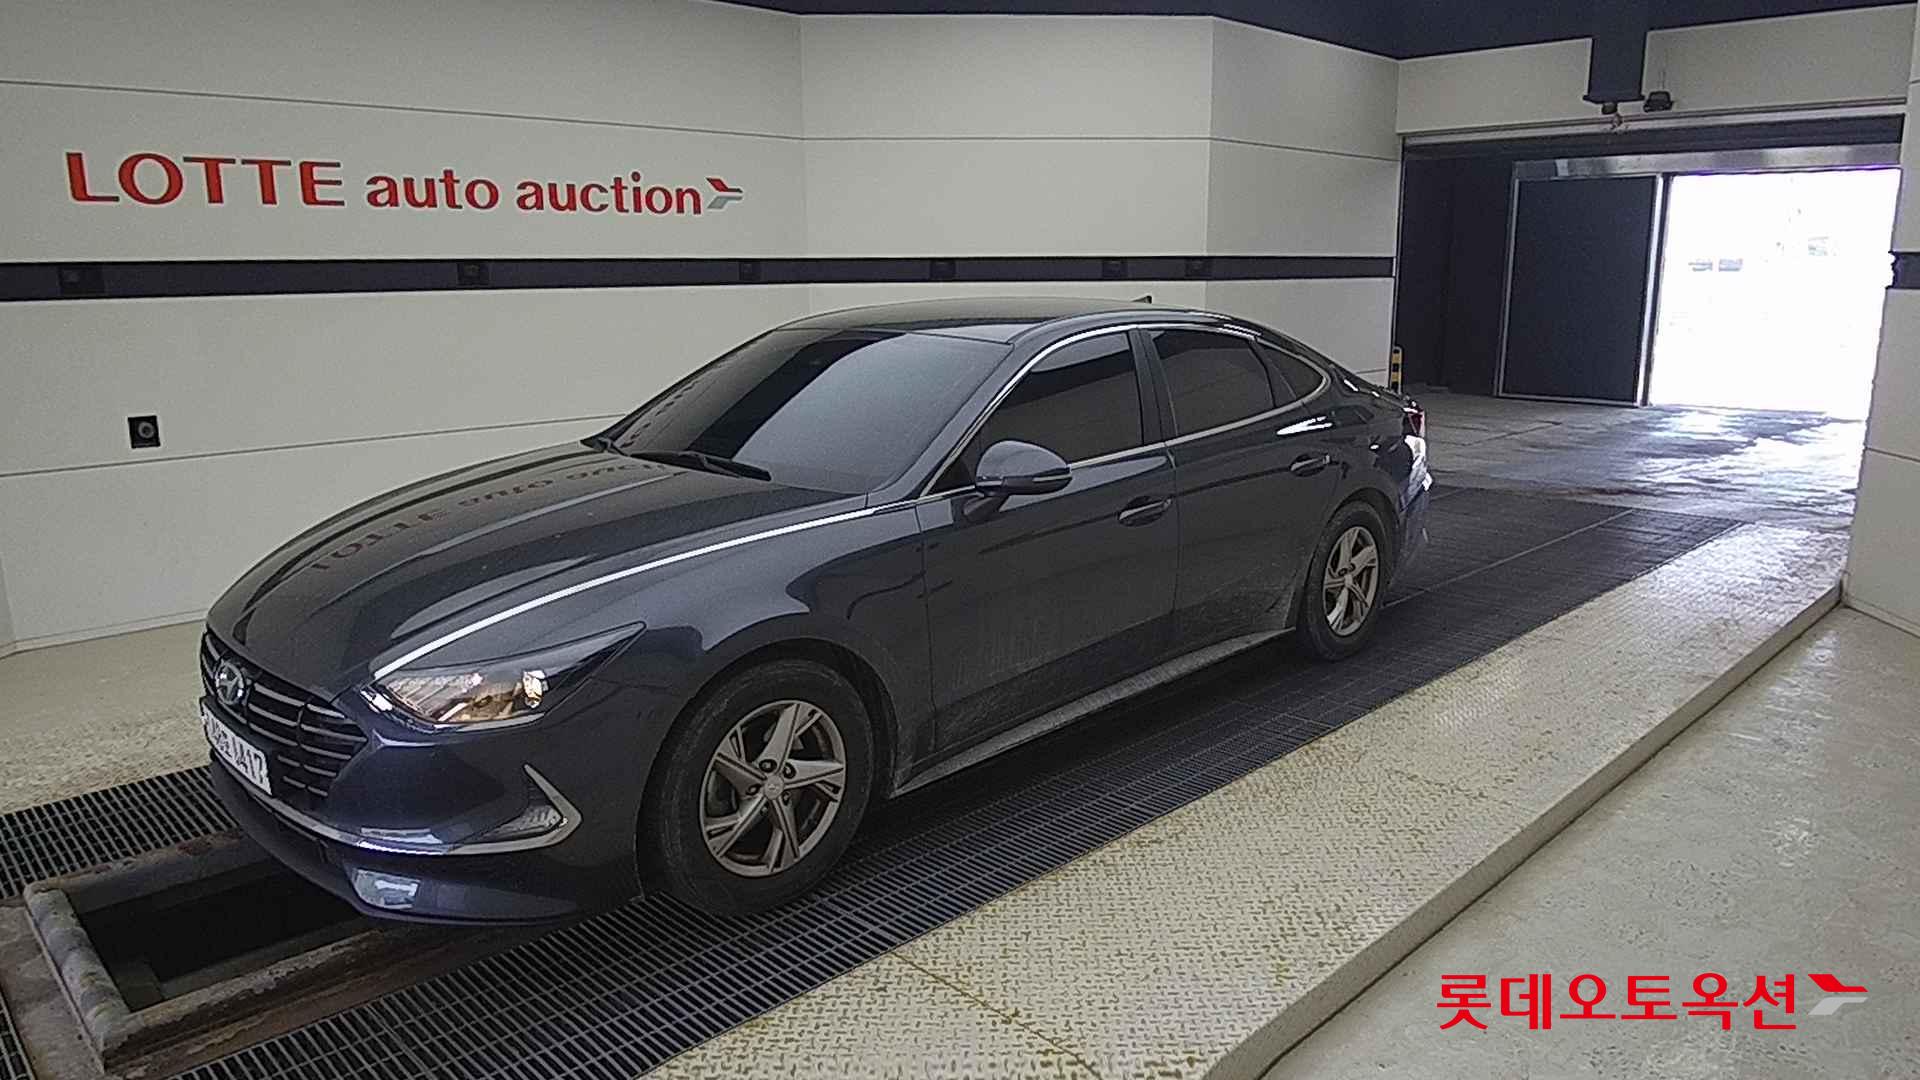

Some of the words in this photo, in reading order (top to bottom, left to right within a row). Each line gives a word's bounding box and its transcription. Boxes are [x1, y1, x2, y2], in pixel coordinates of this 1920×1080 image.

[66, 152, 346, 207] LOTTE
[366, 169, 500, 210] auto
[515, 172, 702, 215] auction
